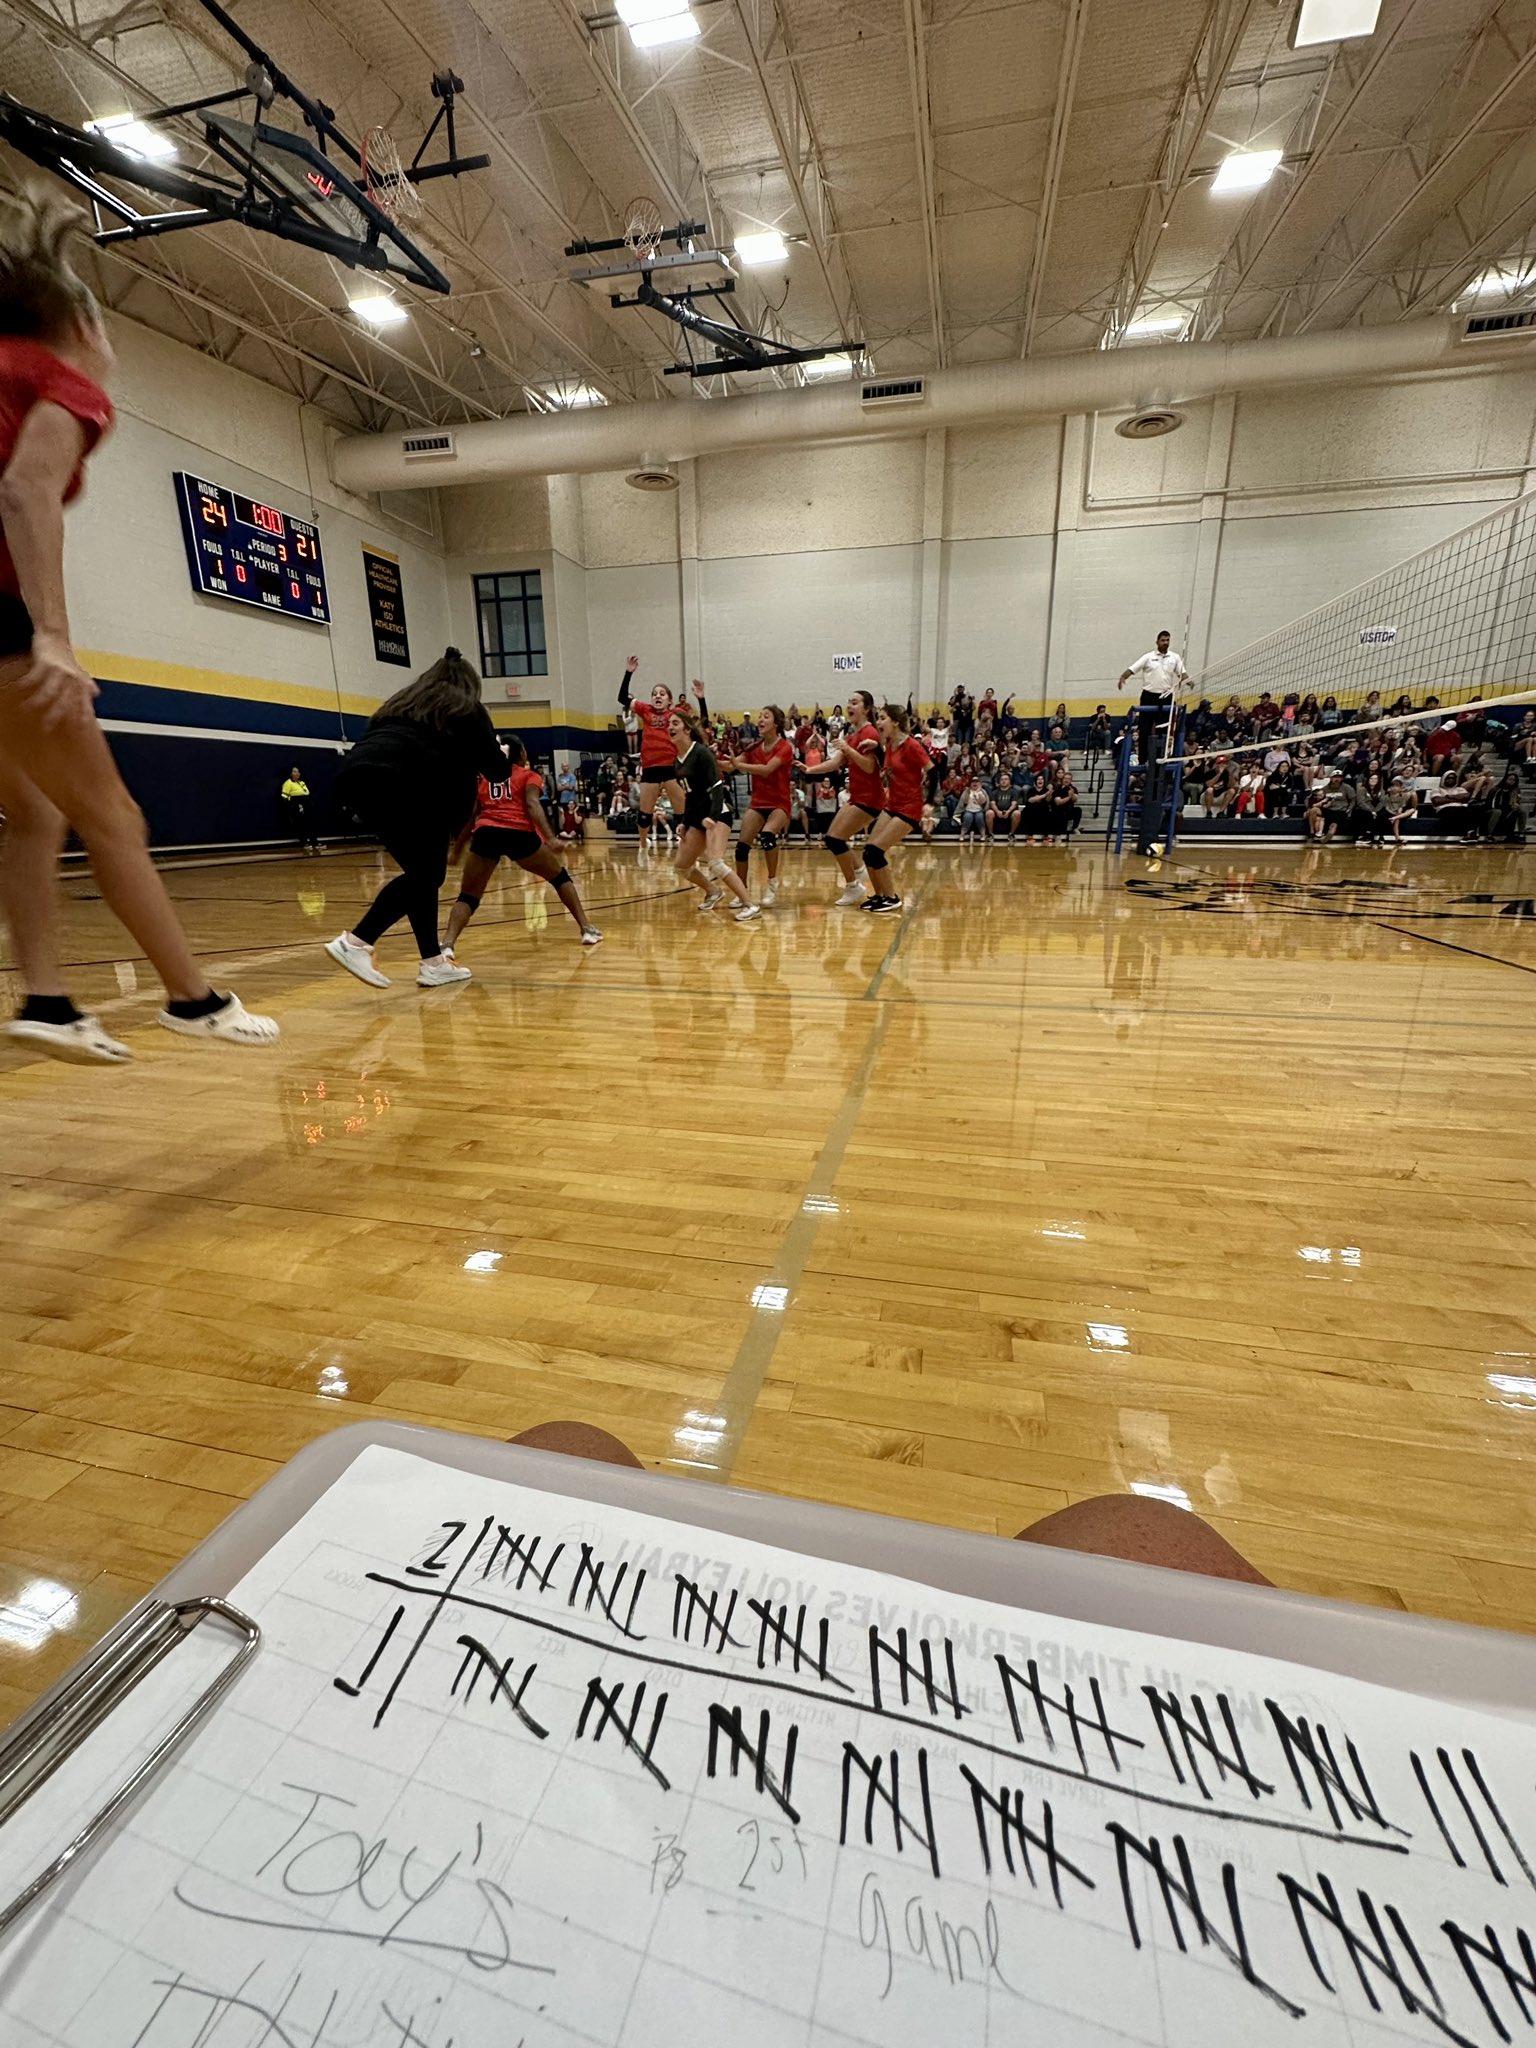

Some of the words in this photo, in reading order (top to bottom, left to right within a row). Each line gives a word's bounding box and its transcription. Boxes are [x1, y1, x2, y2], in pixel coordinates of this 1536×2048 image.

[198, 481, 220, 499] HOME
[201, 497, 227, 527] 24
[252, 503, 283, 534] 1:00
[290, 519, 315, 537] GUESTS
[202, 539, 223, 556] FOULS
[251, 538, 277, 557] PERIOD
[278, 543, 287, 561] 3
[296, 534, 317, 560] 21
[217, 559, 223, 575] 1
[236, 564, 246, 583] 0
[253, 556, 280, 575] PLAYER
[210, 576, 228, 592] WON
[305, 573, 322, 588] FOULS
[373, 580, 397, 593] PROVIDER
[291, 581, 300, 599] 0
[316, 591, 322, 605] 1
[262, 591, 282, 607] GAME
[379, 599, 395, 611] KATY
[311, 606, 325, 619] WON
[383, 610, 394, 621] ISD
[374, 618, 405, 635] ATHLETICS
[1359, 631, 1396, 644] VISITOR
[833, 655, 862, 670] HOME
[859, 1871, 1026, 2001] game
